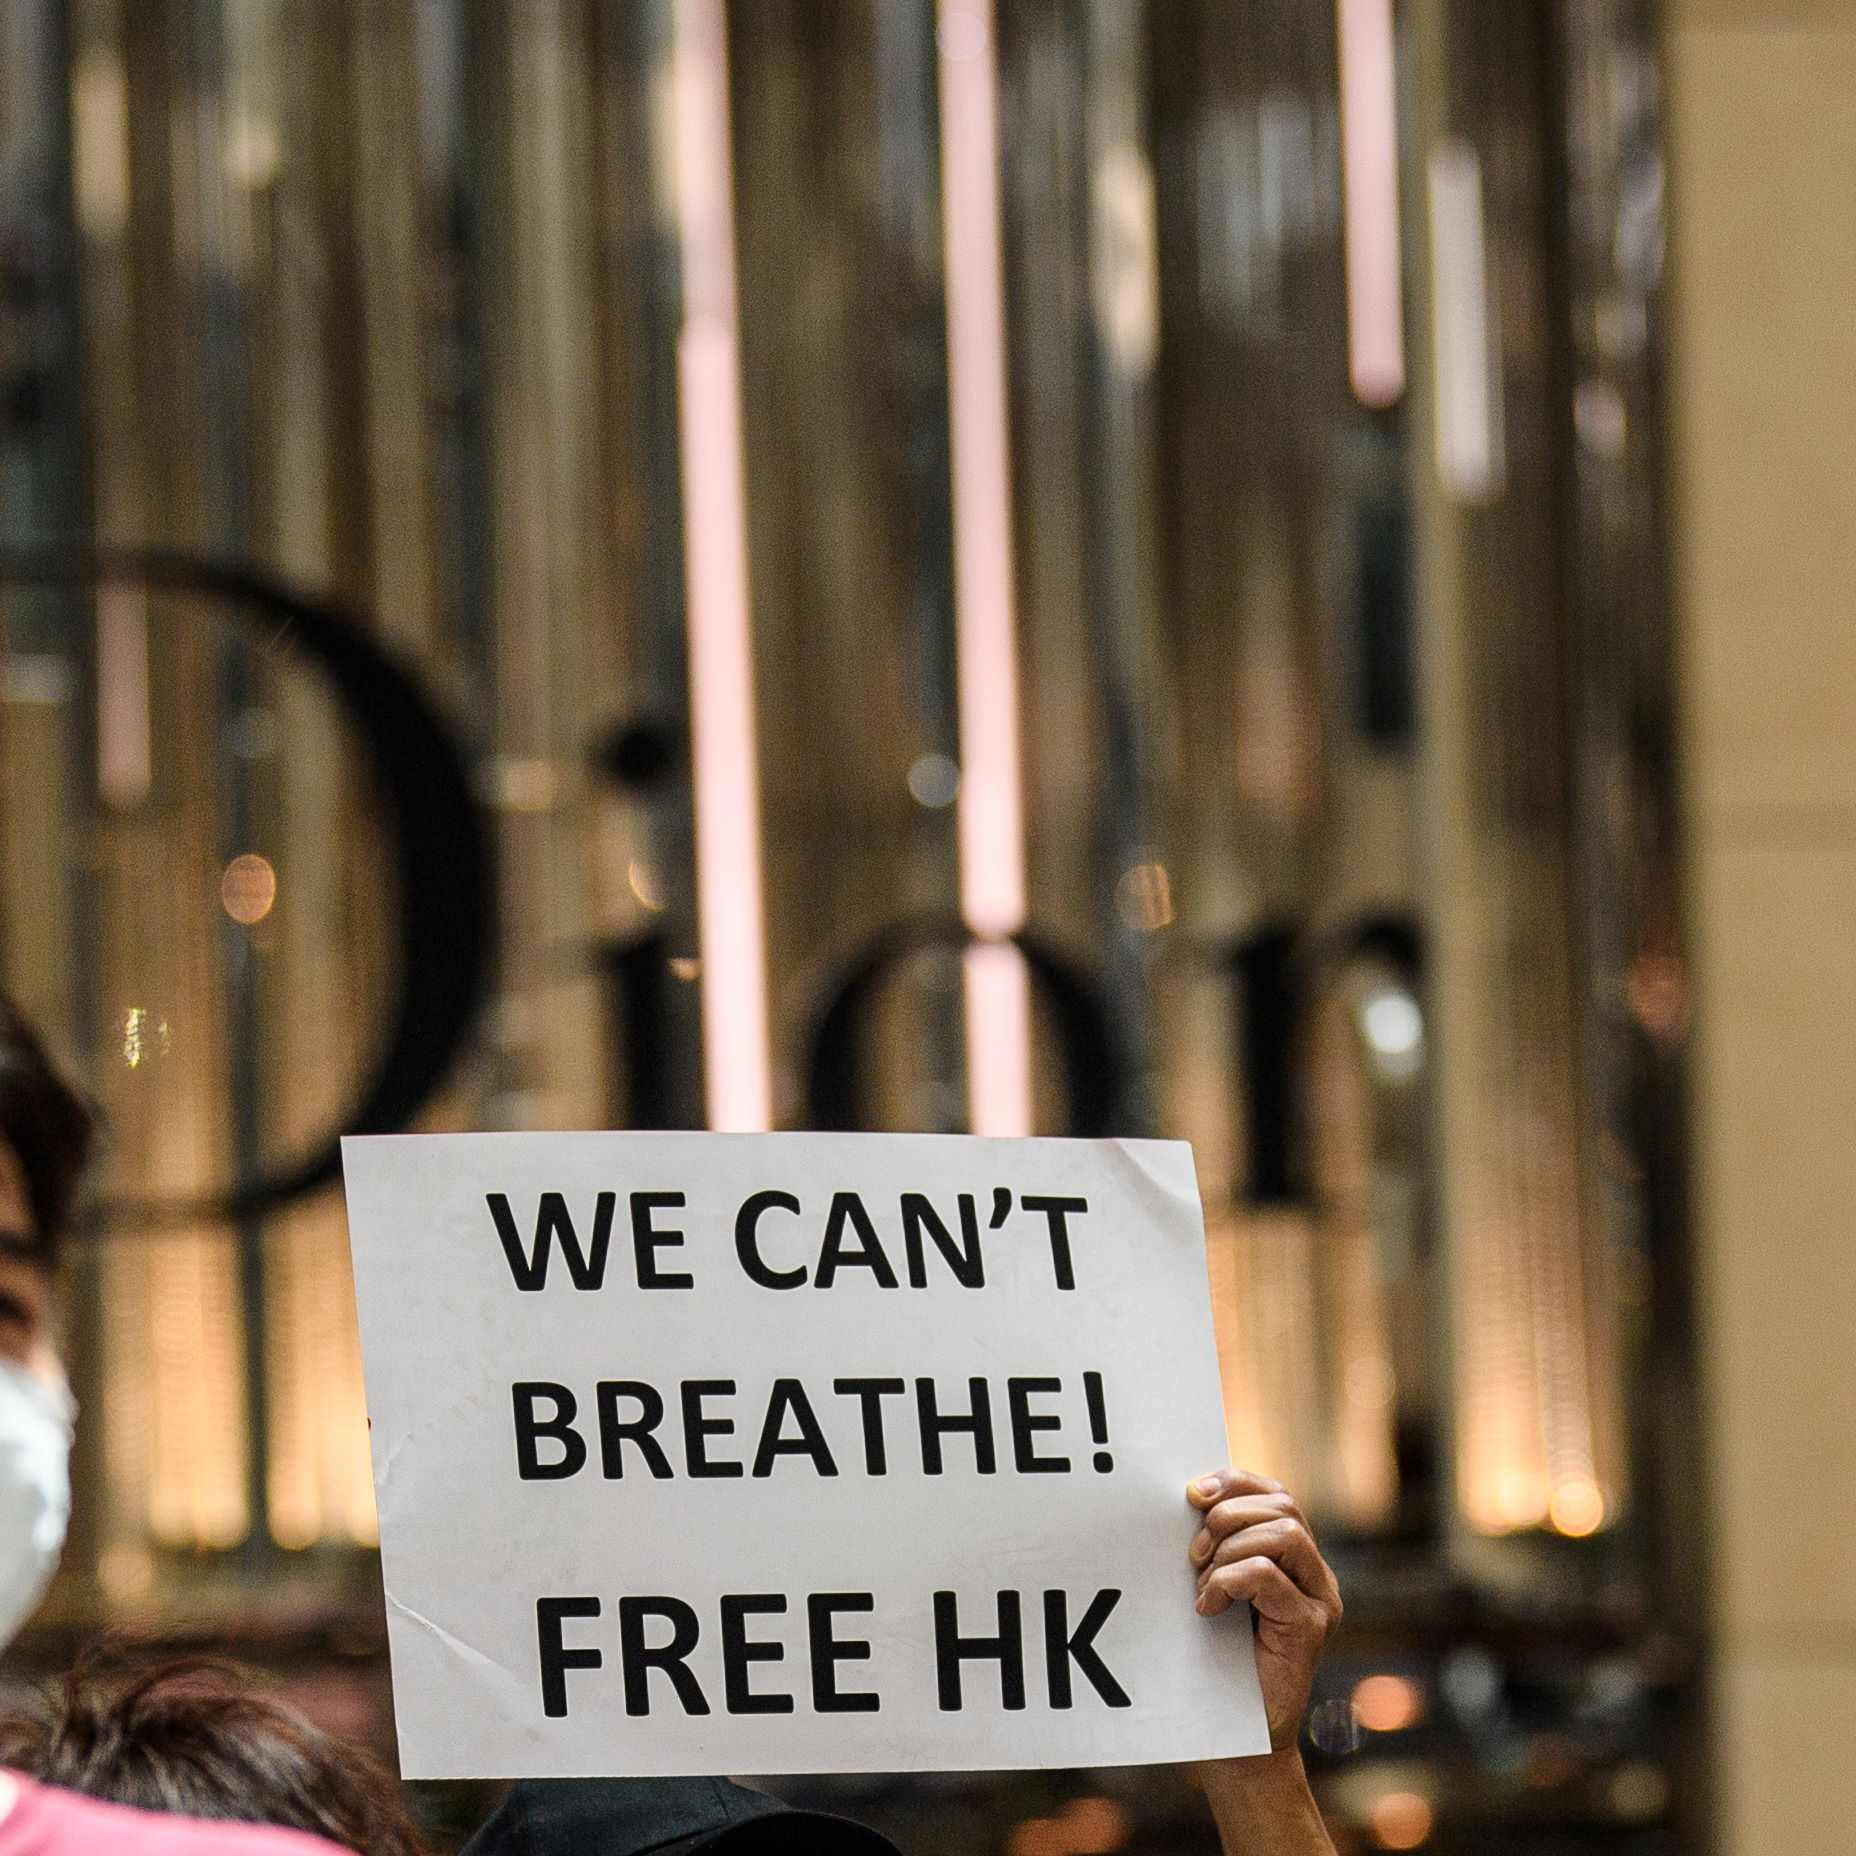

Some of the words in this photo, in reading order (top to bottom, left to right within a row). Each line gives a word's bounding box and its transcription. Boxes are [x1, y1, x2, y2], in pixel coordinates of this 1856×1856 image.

[484, 1190, 695, 1293] WE
[733, 1186, 1089, 1292] CAN'T
[510, 1370, 1115, 1482] BREATHE!
[535, 1591, 882, 1719] FREE
[931, 1587, 1133, 1713] HK
